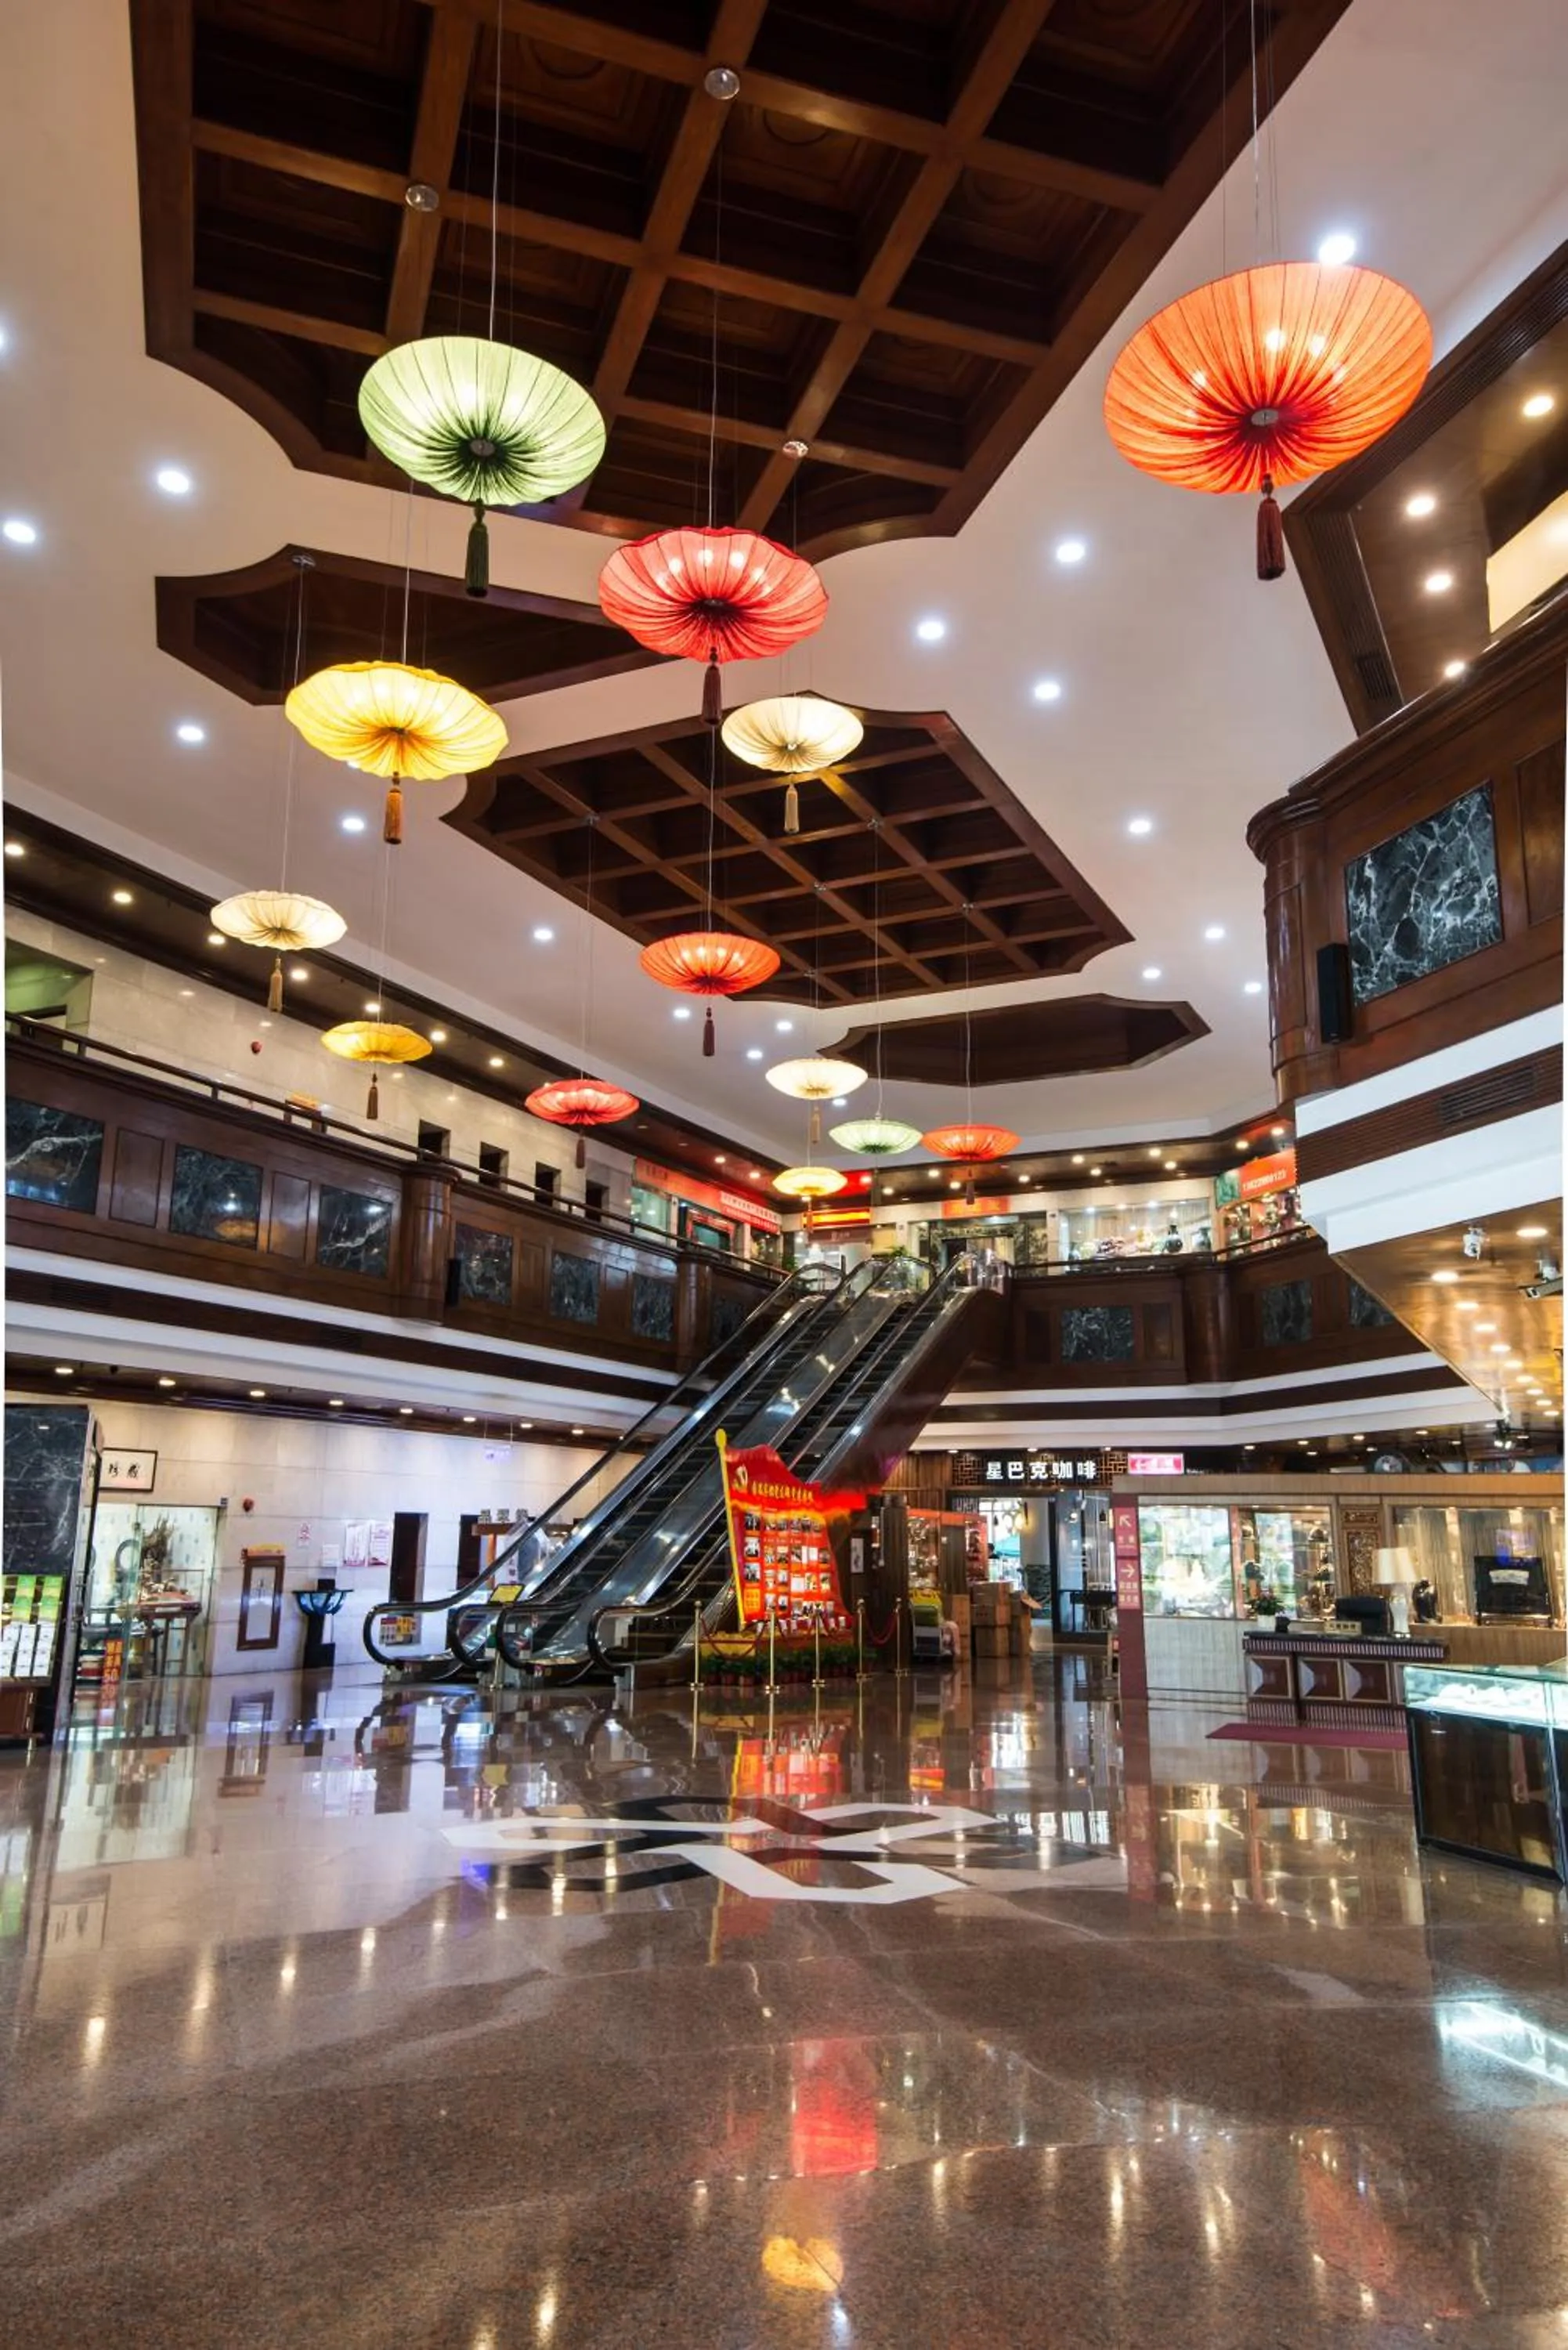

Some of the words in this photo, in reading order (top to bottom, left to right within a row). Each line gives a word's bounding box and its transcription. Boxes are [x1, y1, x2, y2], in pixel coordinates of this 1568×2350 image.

[986, 1460, 1097, 1480] 星巴克咖啡
